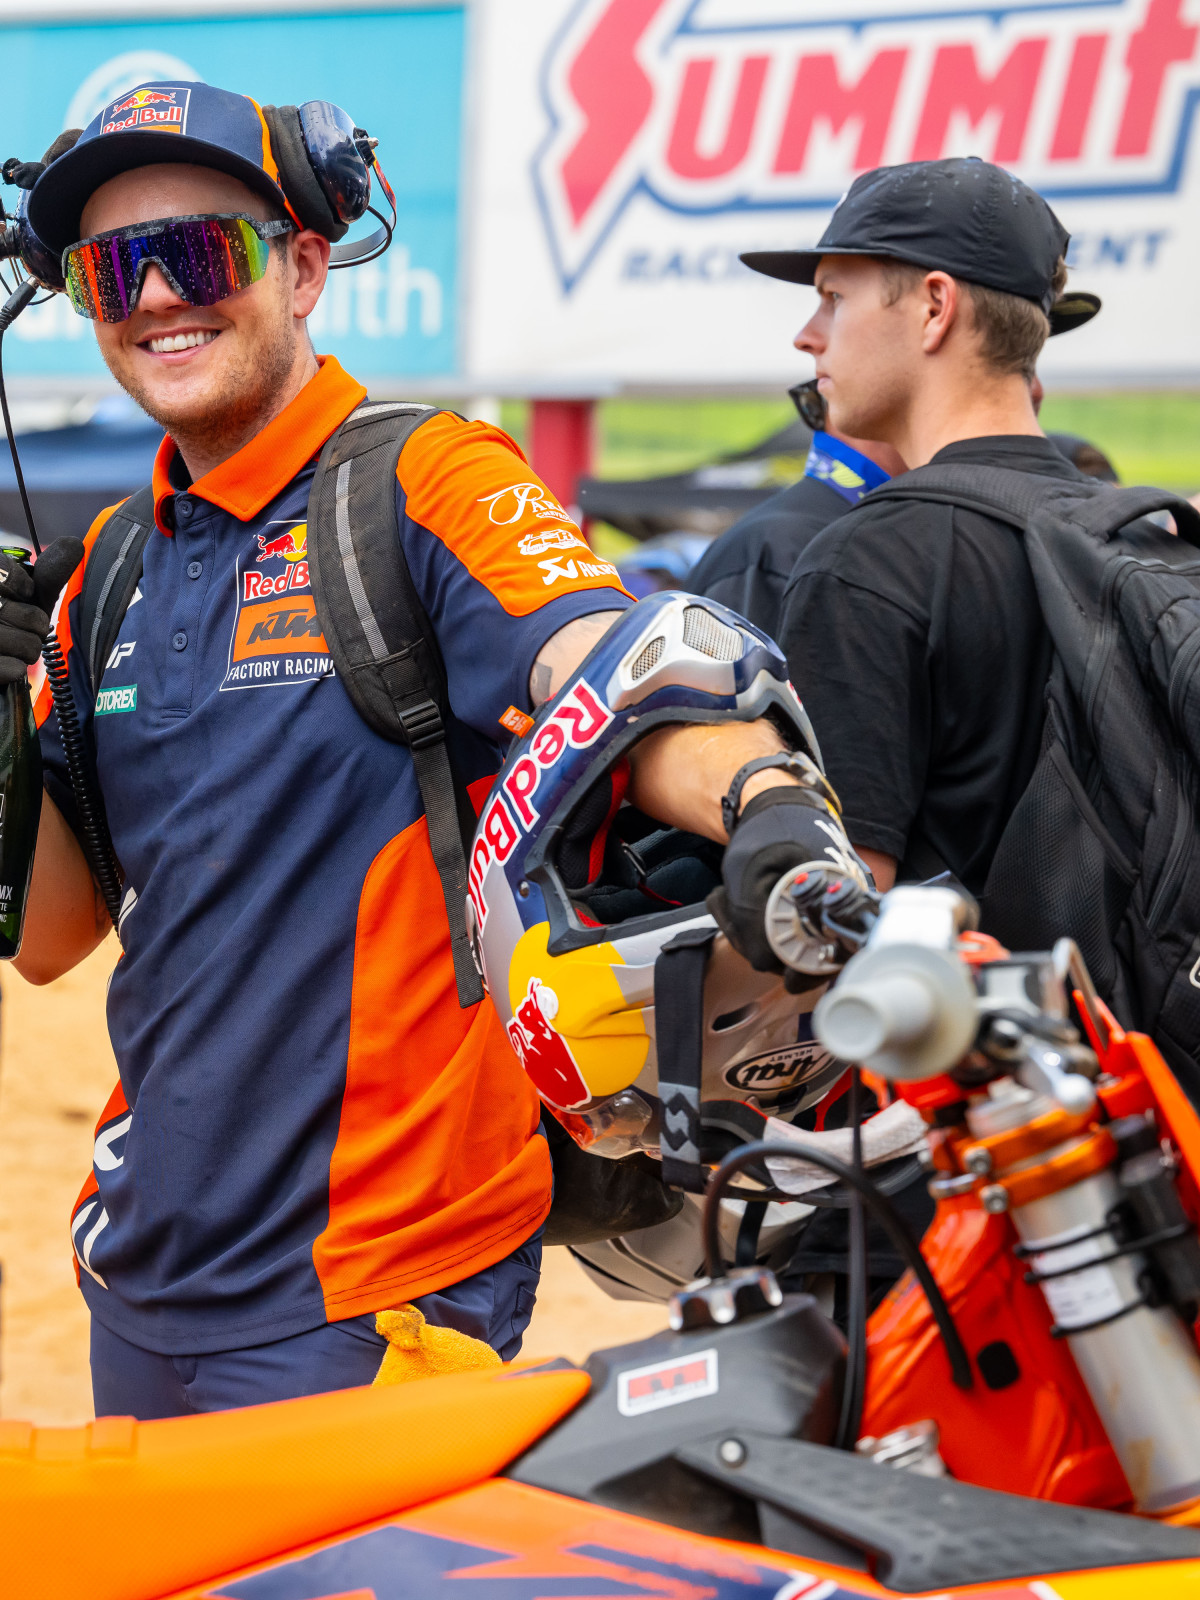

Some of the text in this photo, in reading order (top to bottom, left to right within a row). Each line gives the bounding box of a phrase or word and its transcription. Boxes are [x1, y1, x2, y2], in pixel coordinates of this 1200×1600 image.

[103, 106, 182, 133] Red Bull
[243, 563, 292, 602] Red
[227, 657, 335, 682] FACTORY RACIN
[96, 688, 137, 712] OTOREX
[503, 676, 616, 833] Red
[467, 790, 522, 938] Bull
[770, 1048, 813, 1062] HELMET
